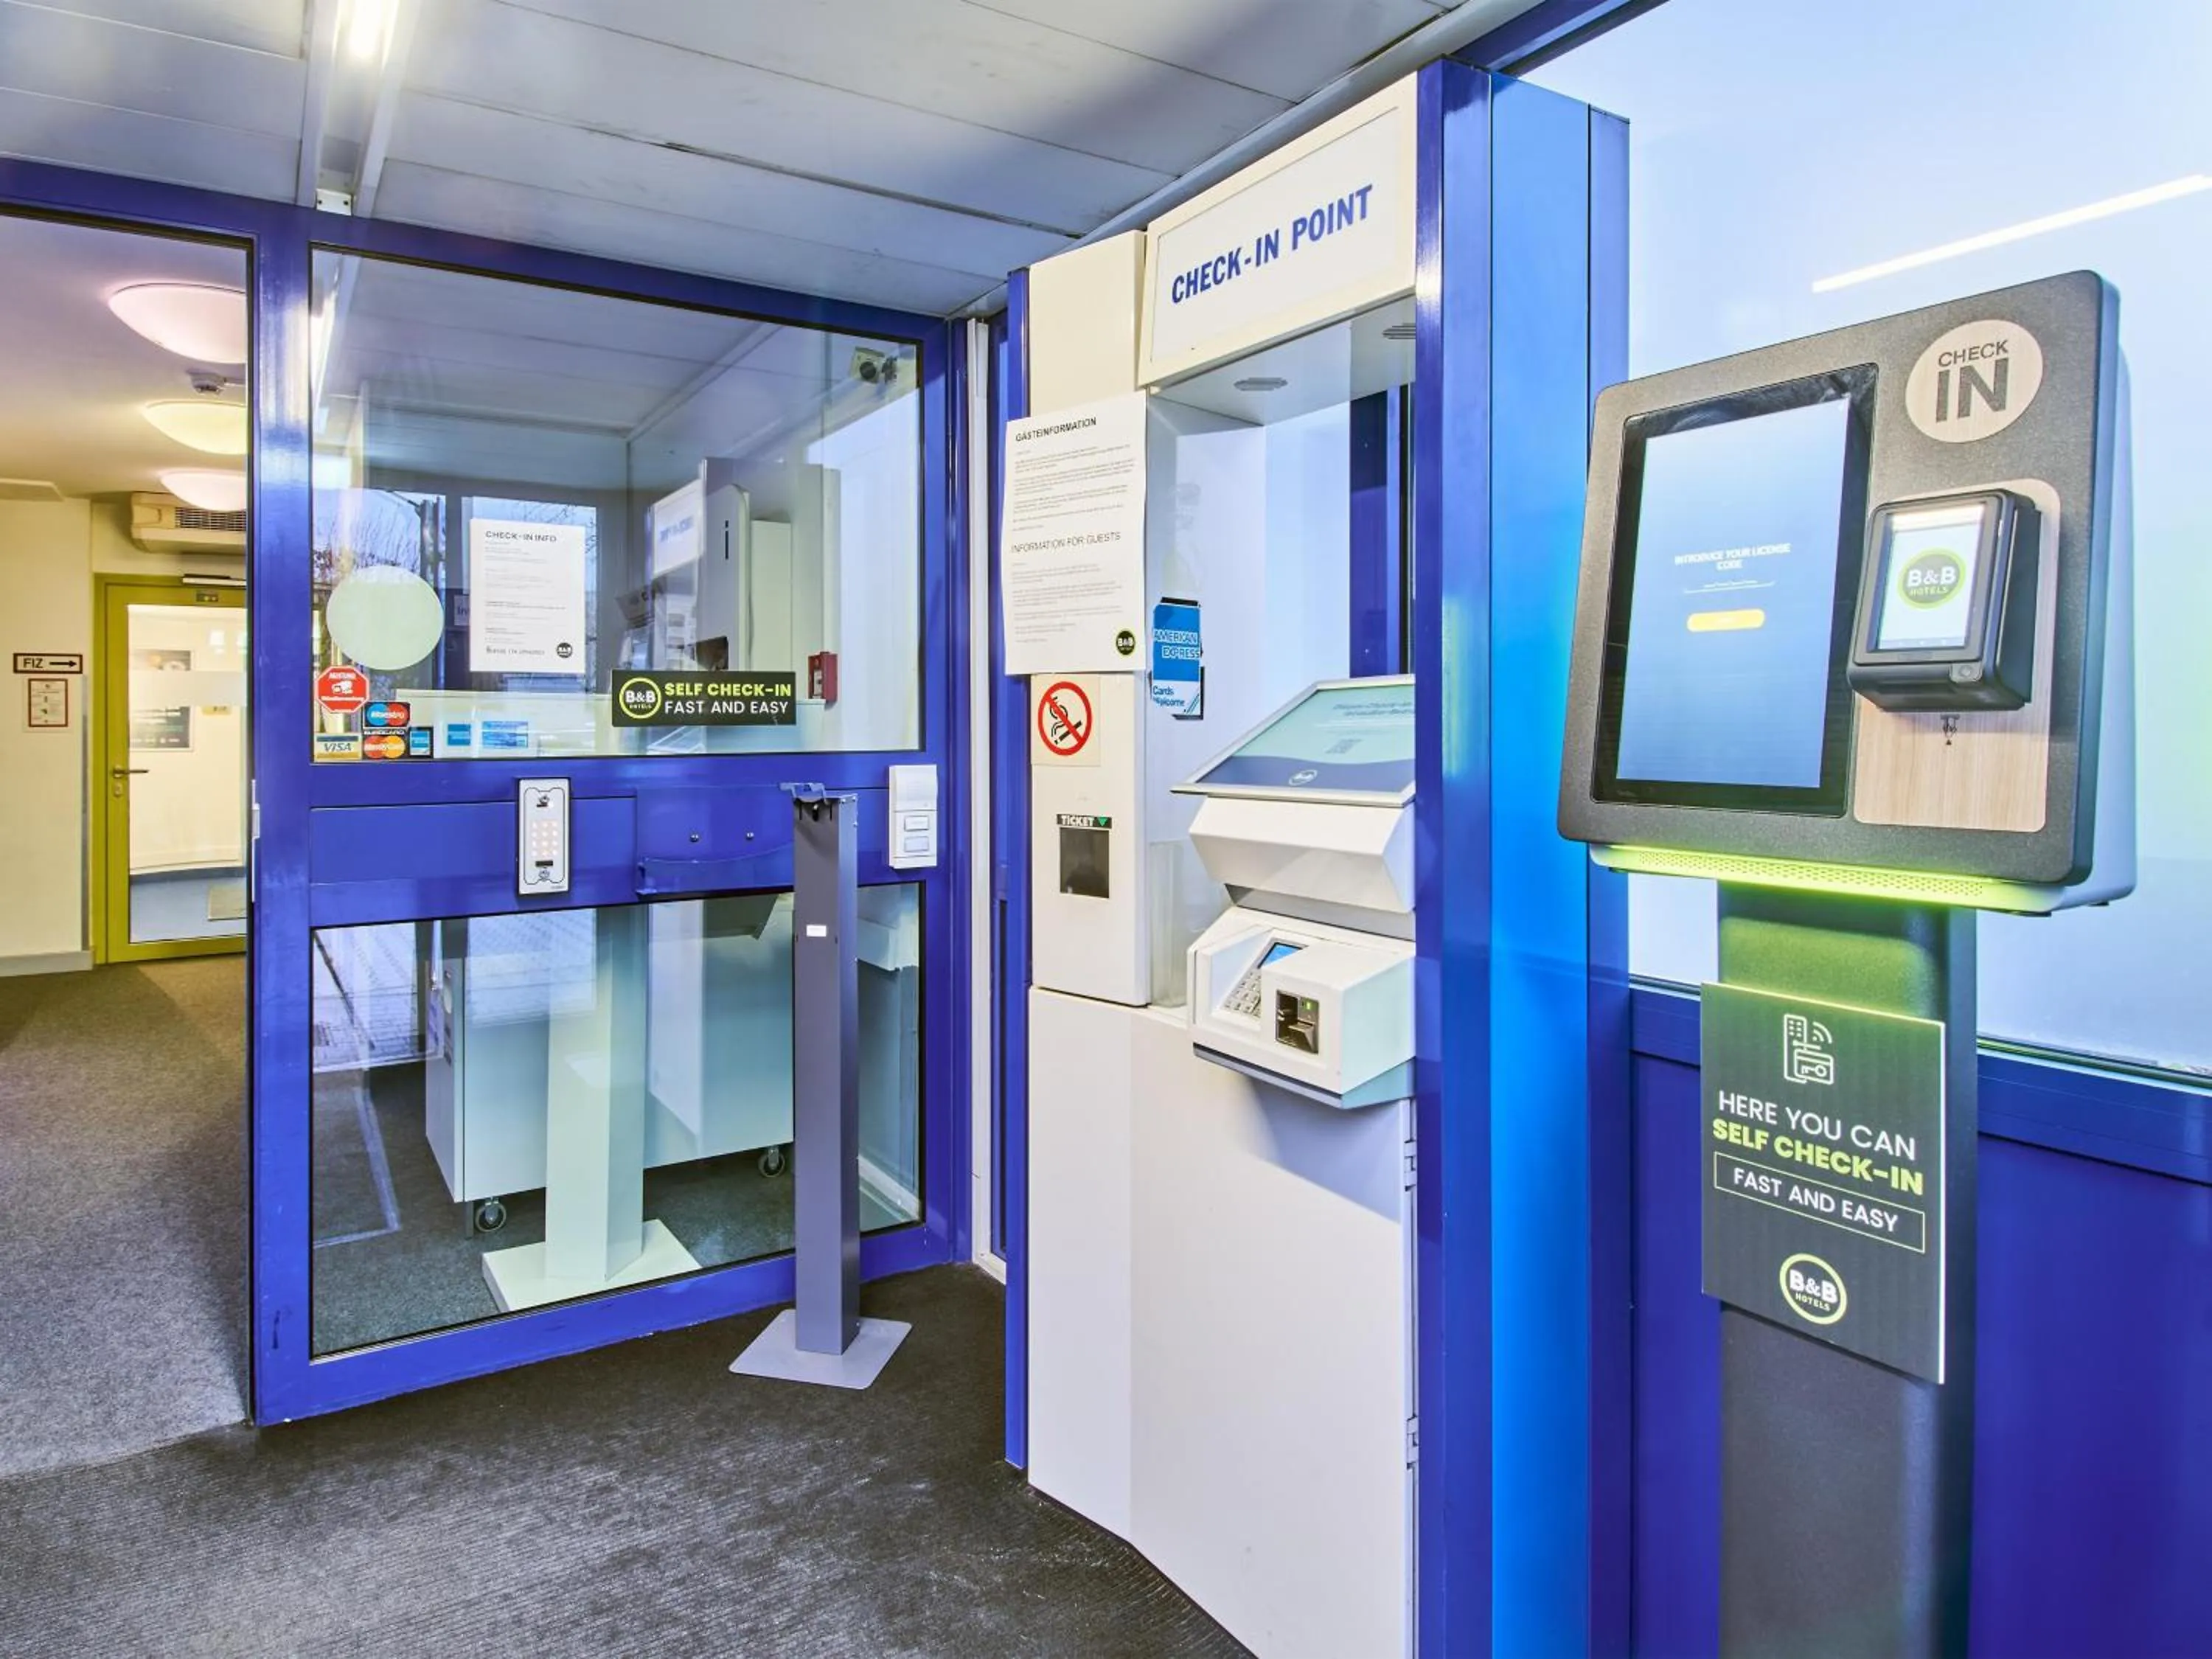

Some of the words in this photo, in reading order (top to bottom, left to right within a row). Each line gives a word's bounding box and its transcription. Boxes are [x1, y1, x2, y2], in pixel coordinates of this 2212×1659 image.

[1172, 228, 1280, 305] CHECK-IN
[1291, 184, 1373, 251] POINT
[1938, 339, 2009, 367] CHECK
[1935, 357, 2009, 424] IN
[1011, 537, 1065, 553] INFORMATION
[1067, 535, 1085, 546] FOR
[1086, 531, 1121, 544] GUESTS
[1907, 566, 1957, 588] B&B
[1153, 629, 1198, 644] AMERICAN
[23, 657, 44, 669] FIZ
[1161, 646, 1200, 661] EXPRESS
[625, 690, 656, 703] B&B
[664, 683, 702, 696] SELF
[707, 684, 791, 697] CHECK-IN
[664, 700, 703, 714] FAST
[711, 700, 745, 714] AND
[751, 701, 788, 714] EASY
[324, 742, 352, 752] VISA
[1061, 815, 1095, 827] TICKET
[1719, 1091, 1778, 1125] HERE
[1786, 1106, 1841, 1141] YOU
[1851, 1124, 1916, 1161] CAN
[1713, 1118, 1769, 1151] SELF
[1773, 1135, 1924, 1196] CHECK-IN
[1733, 1167, 1781, 1197] FAST
[1789, 1185, 1835, 1214] AND
[1842, 1200, 1898, 1233] EASY
[1790, 1268, 1838, 1304] B&B
[1795, 1293, 1831, 1312] HOTELS
